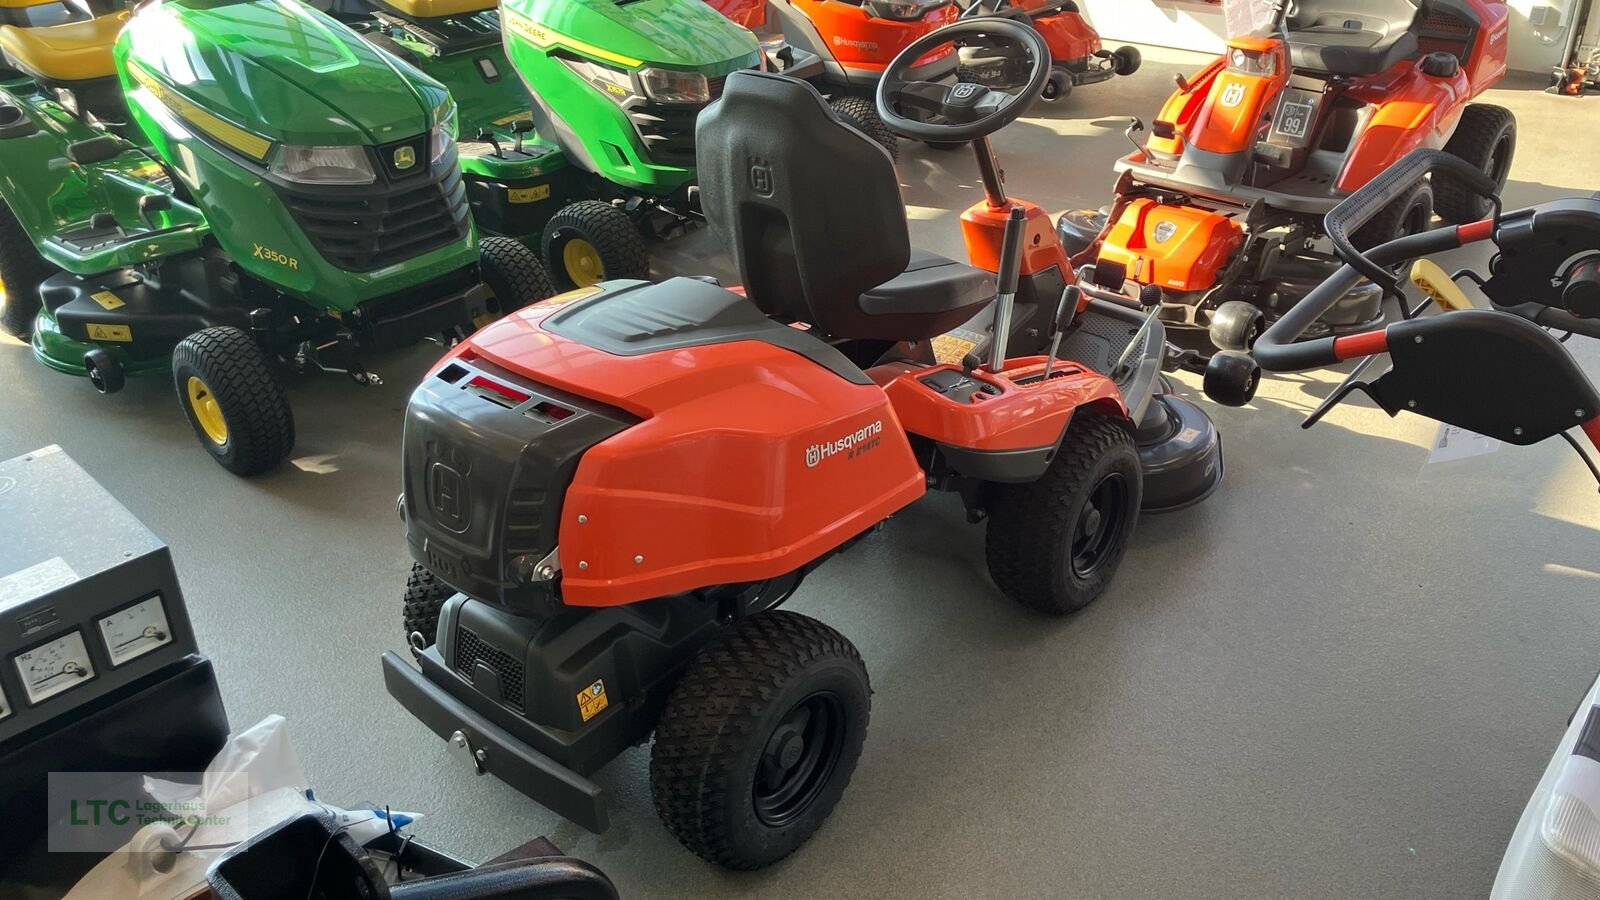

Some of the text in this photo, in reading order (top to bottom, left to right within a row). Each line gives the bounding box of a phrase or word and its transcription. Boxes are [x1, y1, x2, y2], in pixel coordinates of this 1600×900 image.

[841, 36, 878, 49] Husqvarna
[1284, 116, 1300, 133] 99
[820, 420, 882, 460] Husqvarna
